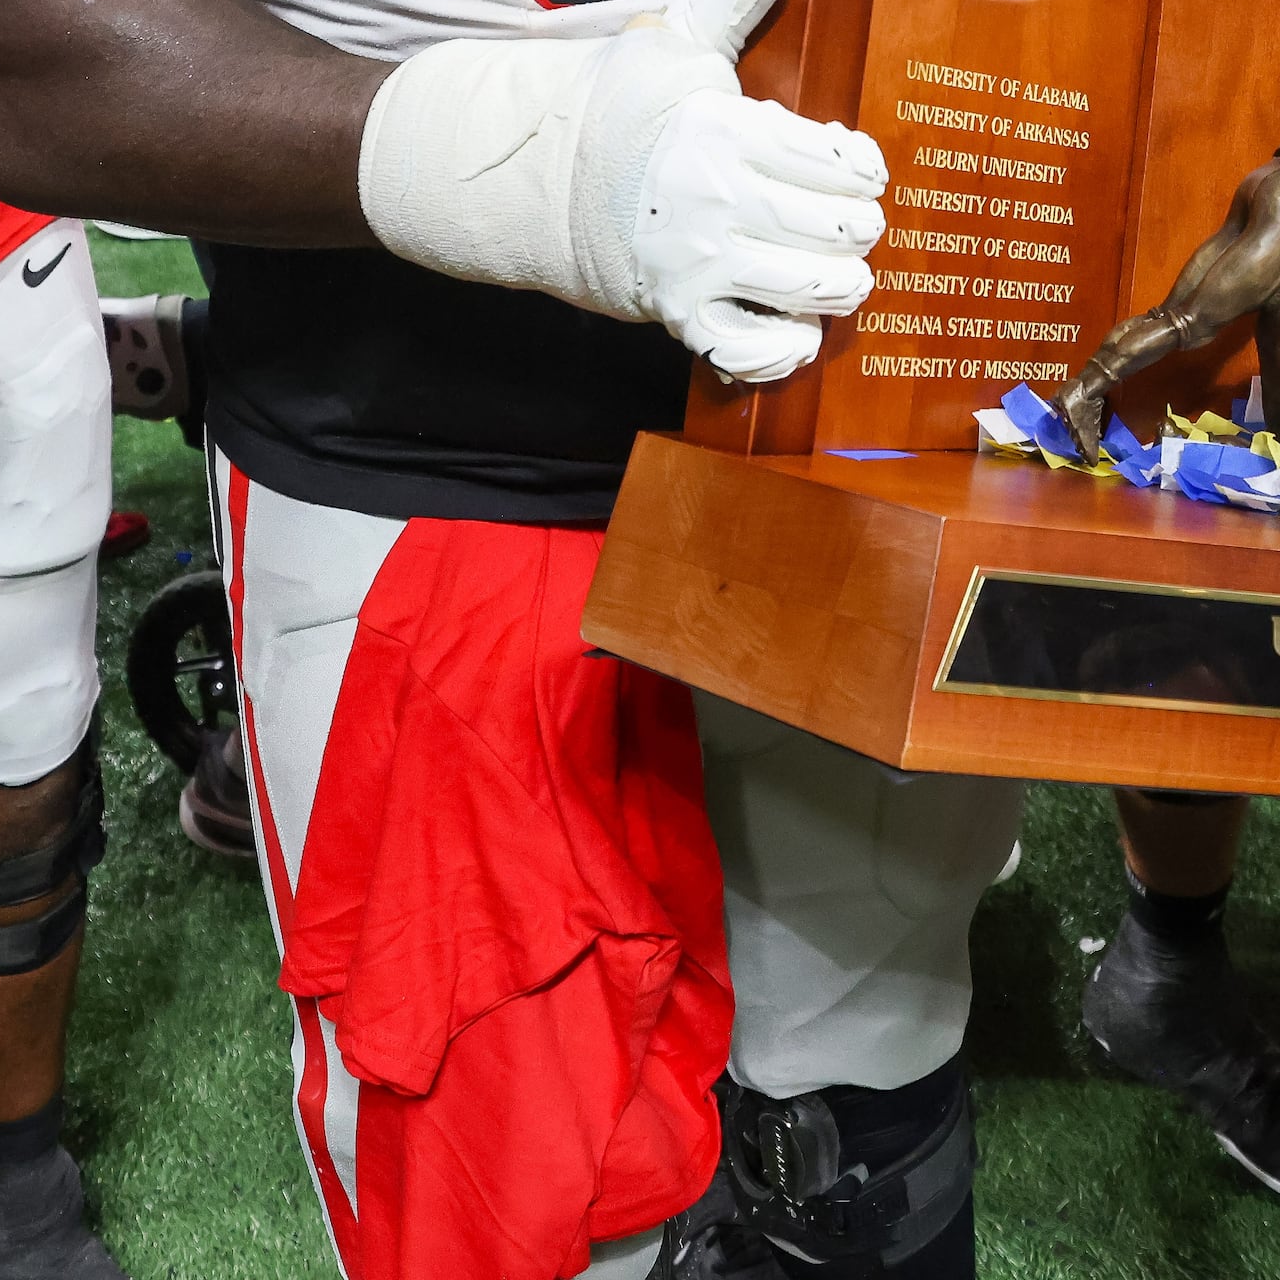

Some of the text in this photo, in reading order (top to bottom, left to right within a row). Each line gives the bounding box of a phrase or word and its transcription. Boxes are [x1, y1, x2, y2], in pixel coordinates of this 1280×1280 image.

[905, 59, 1090, 112] UNIVERSITY OF ALABAMA
[896, 100, 1090, 150] UNIVERSITY OF ARKANSAS
[913, 146, 1067, 185] AUBURN UNIVERSITY
[894, 185, 1074, 225] UNIVERSITY OF FLORIDA
[888, 227, 1071, 265] UNIVERSITY OF GEORGIA
[875, 269, 1074, 304] UNIVERSITY OF KENTUCKY
[856, 311, 1080, 343] LOUISIANA STATE UNIVERSITY
[861, 355, 1068, 382] UNIVERSITY OF MISSISSIPPI
